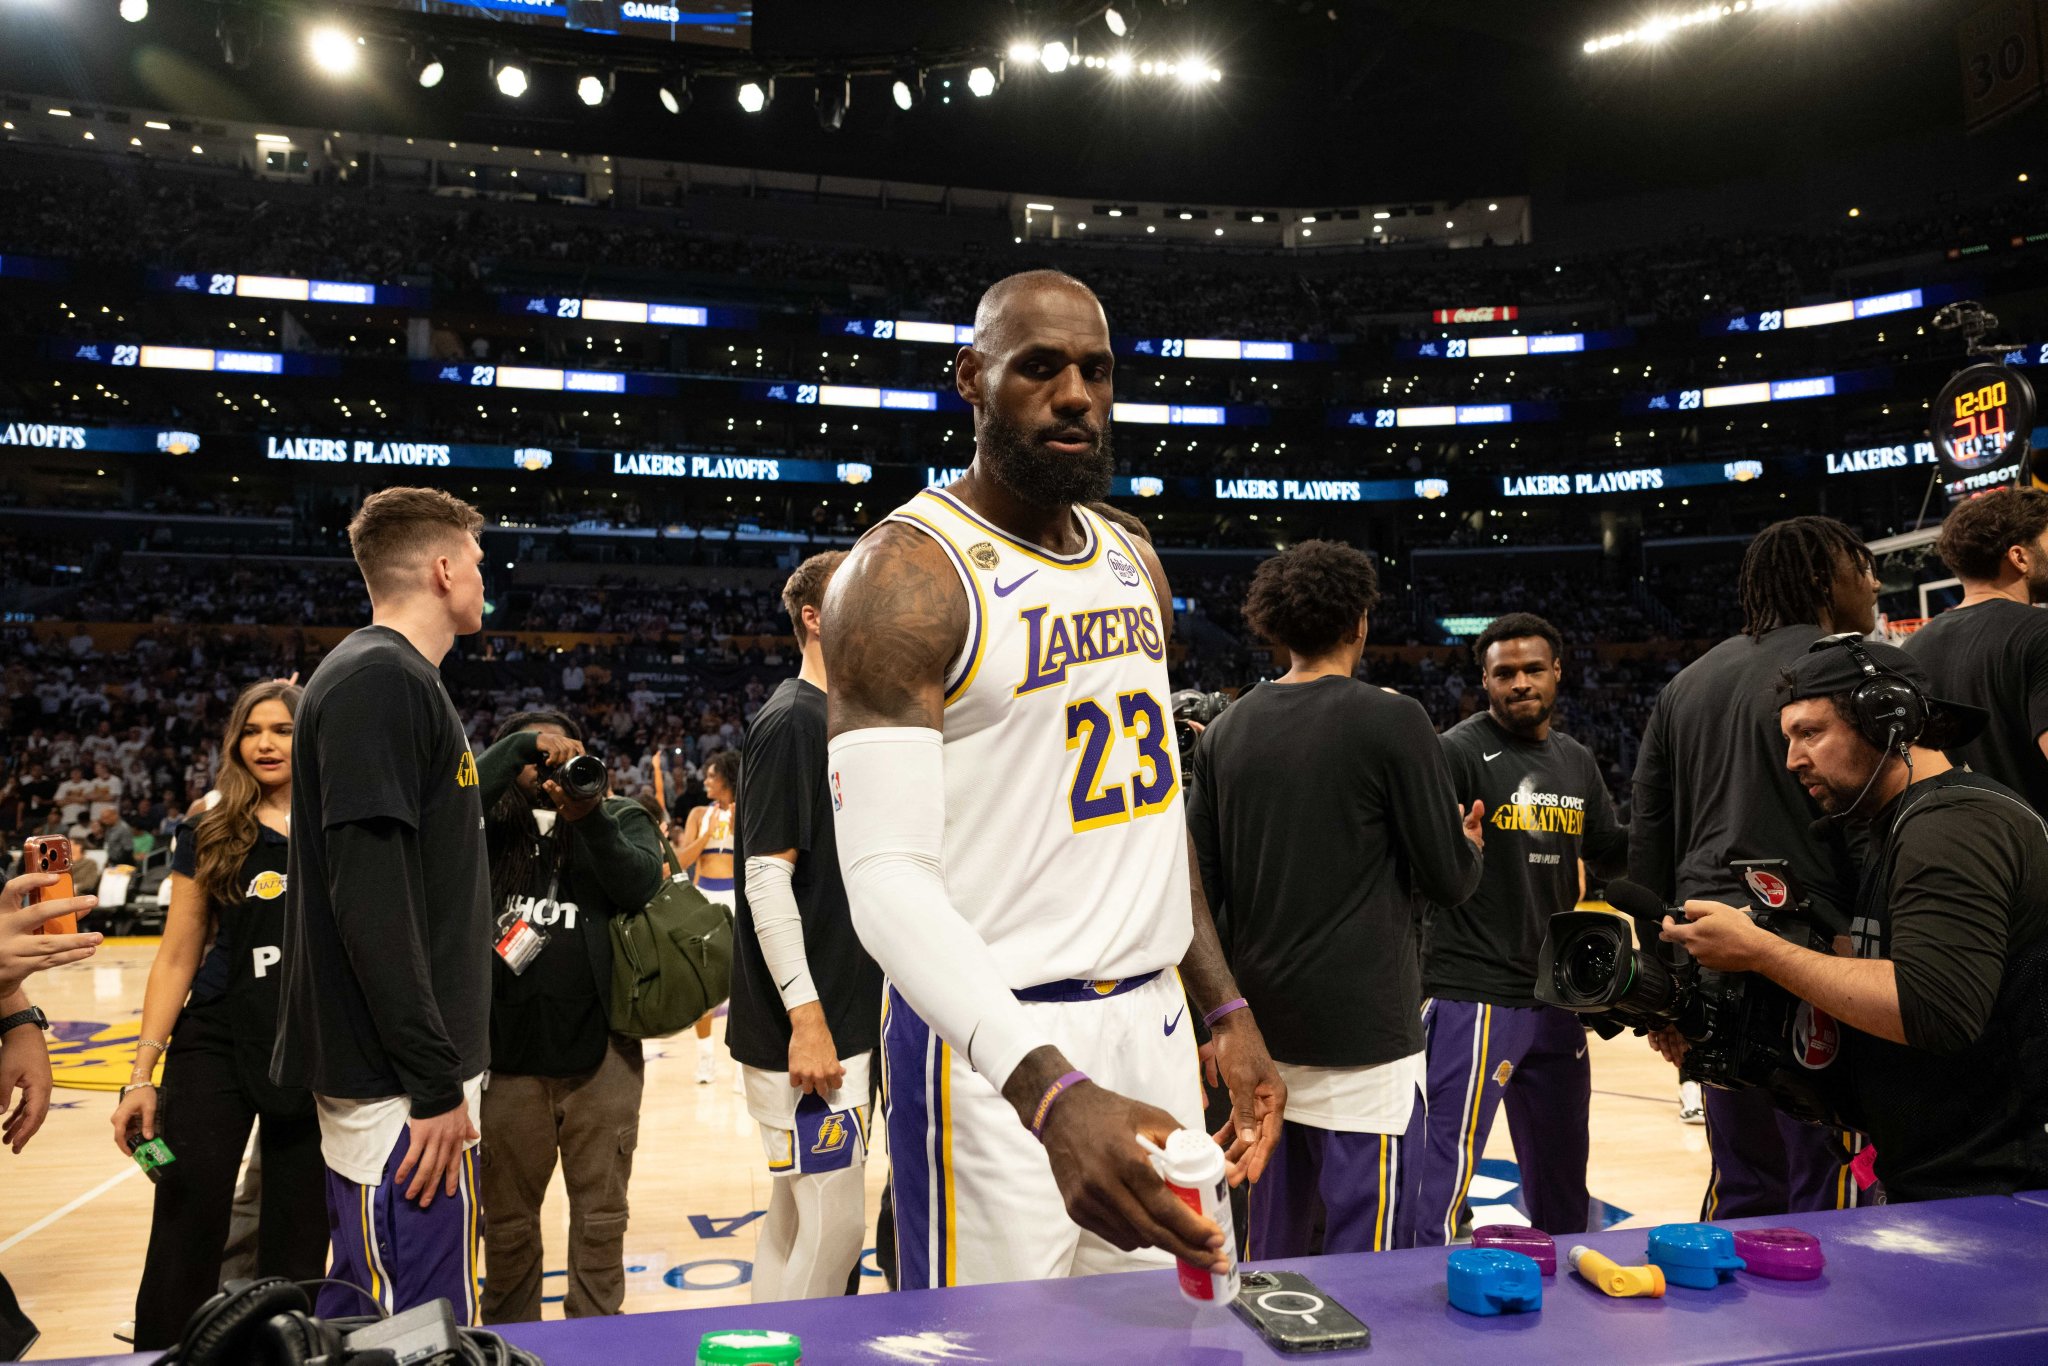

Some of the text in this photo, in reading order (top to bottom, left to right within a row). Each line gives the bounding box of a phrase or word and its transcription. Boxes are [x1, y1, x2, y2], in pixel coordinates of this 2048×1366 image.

[623, 1, 680, 22] GAMES
[209, 274, 235, 296] 23
[557, 298, 581, 318] 23
[873, 319, 895, 339] 23
[1759, 310, 1782, 331] 23
[112, 345, 139, 366] 23
[1161, 339, 1183, 358] 23
[1447, 339, 1467, 358] 23
[2039, 343, 2048, 364] 2
[471, 366, 496, 386] 23
[796, 385, 818, 404] 23
[1679, 389, 1701, 410] 23
[1955, 381, 2007, 419] 12:00
[1375, 409, 1396, 428] 23
[0, 423, 87, 450] AYOFFS
[1952, 407, 2006, 461] 24
[267, 436, 451, 467] LAKERS PLAYOFFS
[1826, 445, 1908, 475] LAKERS
[613, 452, 780, 481] LAKERS PLAYOFFS
[928, 467, 967, 488] LAK
[1964, 464, 2020, 490] TISSOT
[1215, 479, 1361, 501] LAKERS PLAYOFFS
[1503, 467, 1664, 497] LAKERS PLAYOFFS
[1014, 604, 1163, 698] LAKERS
[1065, 688, 1180, 834] 23
[1510, 785, 1584, 810] obsess over
[246, 872, 288, 898] LAKER
[1033, 1086, 1058, 1131] PROMISE
